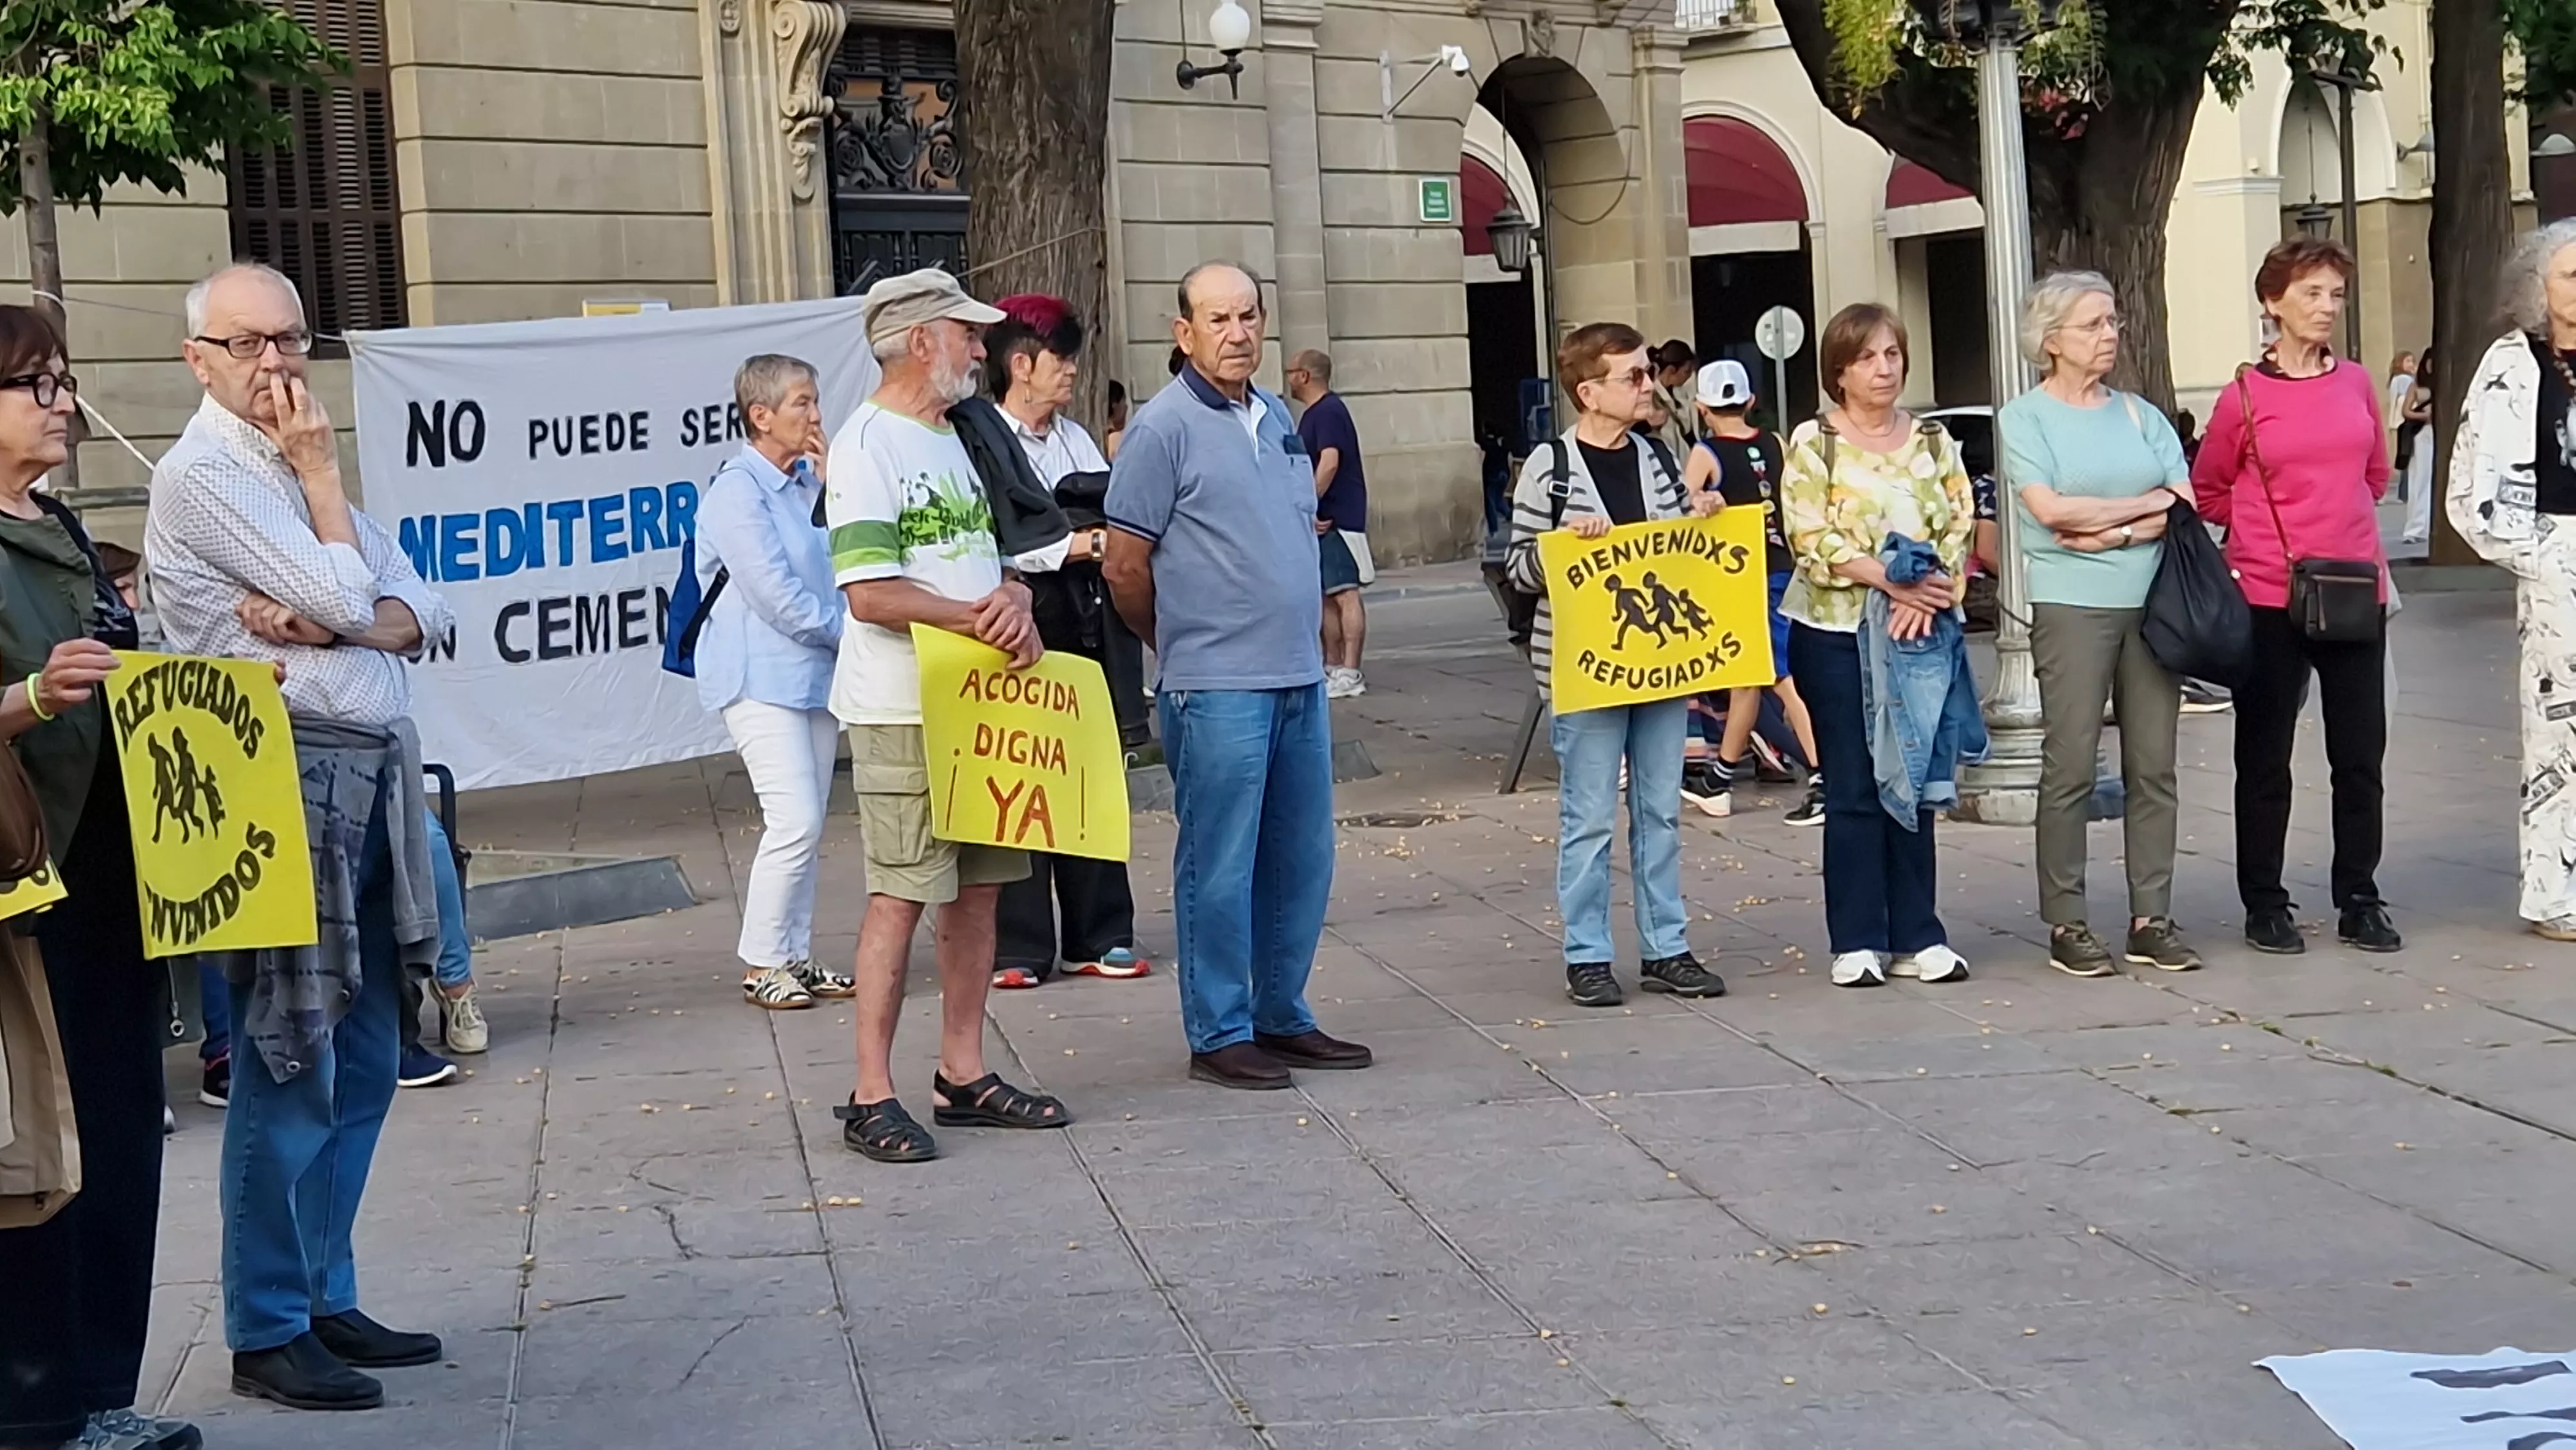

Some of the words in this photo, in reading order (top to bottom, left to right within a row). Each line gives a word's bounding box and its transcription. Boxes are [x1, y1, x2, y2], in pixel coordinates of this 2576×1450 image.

[406, 400, 485, 468] NO
[528, 412, 650, 460] PUEDE
[680, 402, 743, 447] SER
[398, 460, 727, 583] MEDITERR
[1566, 527, 1750, 590] BIENVENIDXS
[1577, 631, 1742, 690] REFUGIADXS
[115, 660, 264, 760] REFUGIADOS
[958, 669, 1080, 721] ACOGIDA
[973, 722, 1066, 776] DIGNA
[144, 821, 276, 946] NVENIDOS
